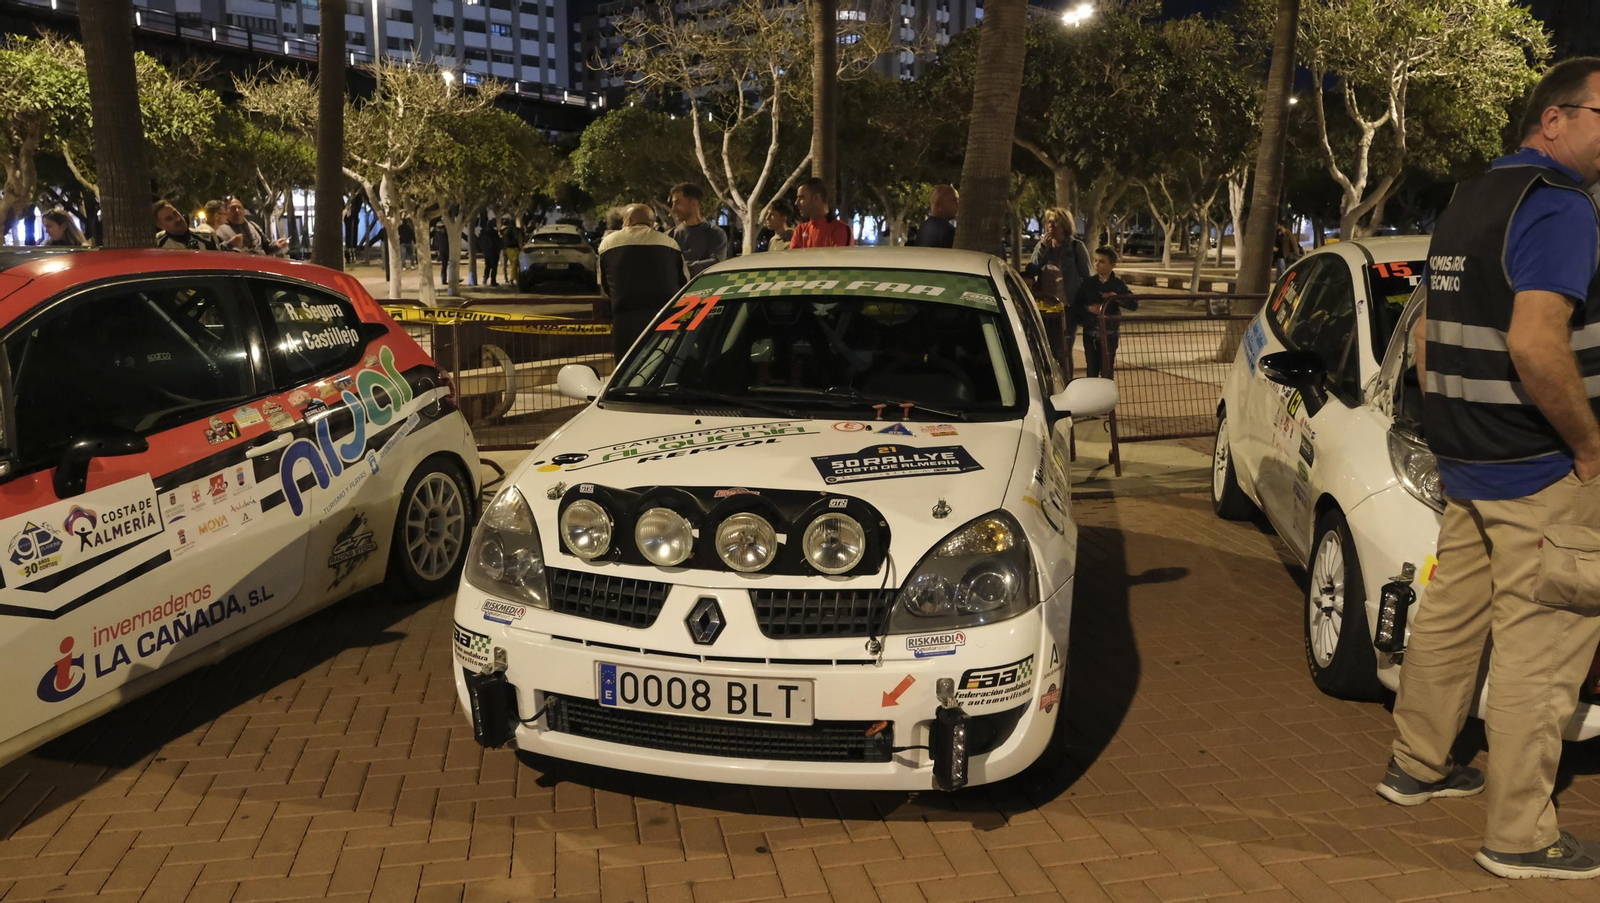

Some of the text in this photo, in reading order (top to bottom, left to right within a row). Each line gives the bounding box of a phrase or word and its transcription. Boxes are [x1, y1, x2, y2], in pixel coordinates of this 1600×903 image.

[1372, 262, 1412, 278] 15
[712, 280, 840, 296] COPA
[845, 281, 946, 297] FAA
[1431, 271, 1460, 292] TÉCNIO
[284, 302, 343, 321] R. Segura
[655, 296, 722, 331] 21
[286, 326, 359, 352] A. Castillejo
[612, 423, 791, 450] CARBURANTES
[637, 438, 781, 463] REPSOL
[877, 446, 896, 454] 21
[831, 452, 956, 469] 50 RALLYE
[834, 466, 878, 475] COSTA
[323, 490, 346, 514] TURISMO
[349, 470, 367, 489] PLAYAS
[101, 497, 152, 524] COSTA DE
[94, 510, 156, 547] ALMERÍA
[38, 557, 50, 566] AÑOS
[39, 561, 58, 571] CONTIGO
[329, 550, 353, 563] RACING
[24, 562, 38, 578] 30
[92, 583, 211, 648] invernaderos
[95, 643, 132, 679] LA
[137, 593, 247, 658] CAÑADA,
[920, 644, 950, 652] motorsport
[605, 671, 799, 718] E 0008 BLT
[1004, 679, 1031, 694] andaluza
[968, 687, 1031, 706] automovilismo
